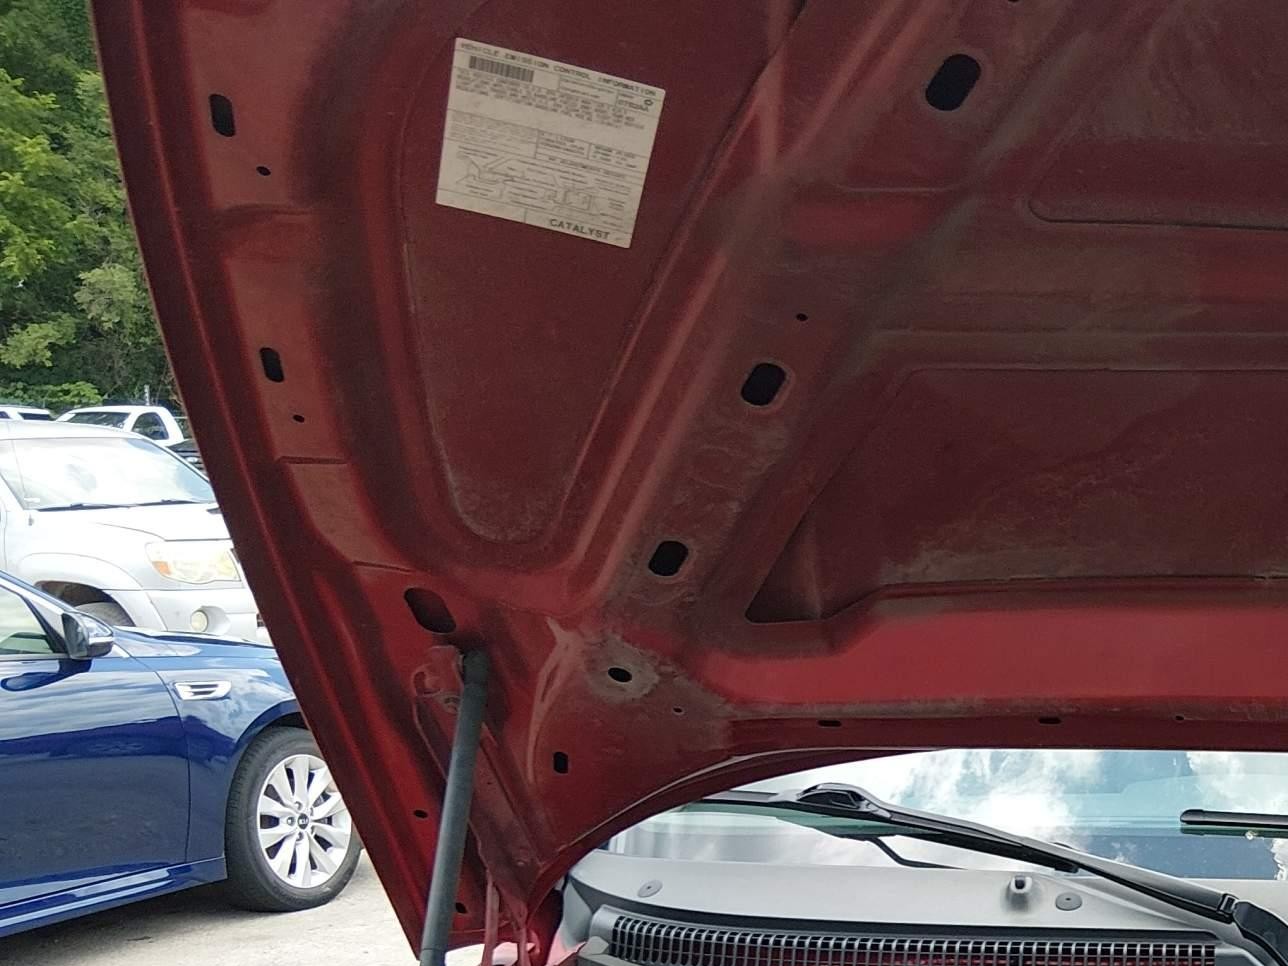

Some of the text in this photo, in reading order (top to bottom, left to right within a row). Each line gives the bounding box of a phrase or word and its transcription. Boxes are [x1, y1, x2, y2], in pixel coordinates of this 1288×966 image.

[461, 42, 500, 58] VEHICLE
[504, 53, 549, 69] EMISSION
[553, 65, 591, 81] CONTROL
[598, 76, 656, 96] INFORMATION
[550, 218, 610, 240] CATALYST
